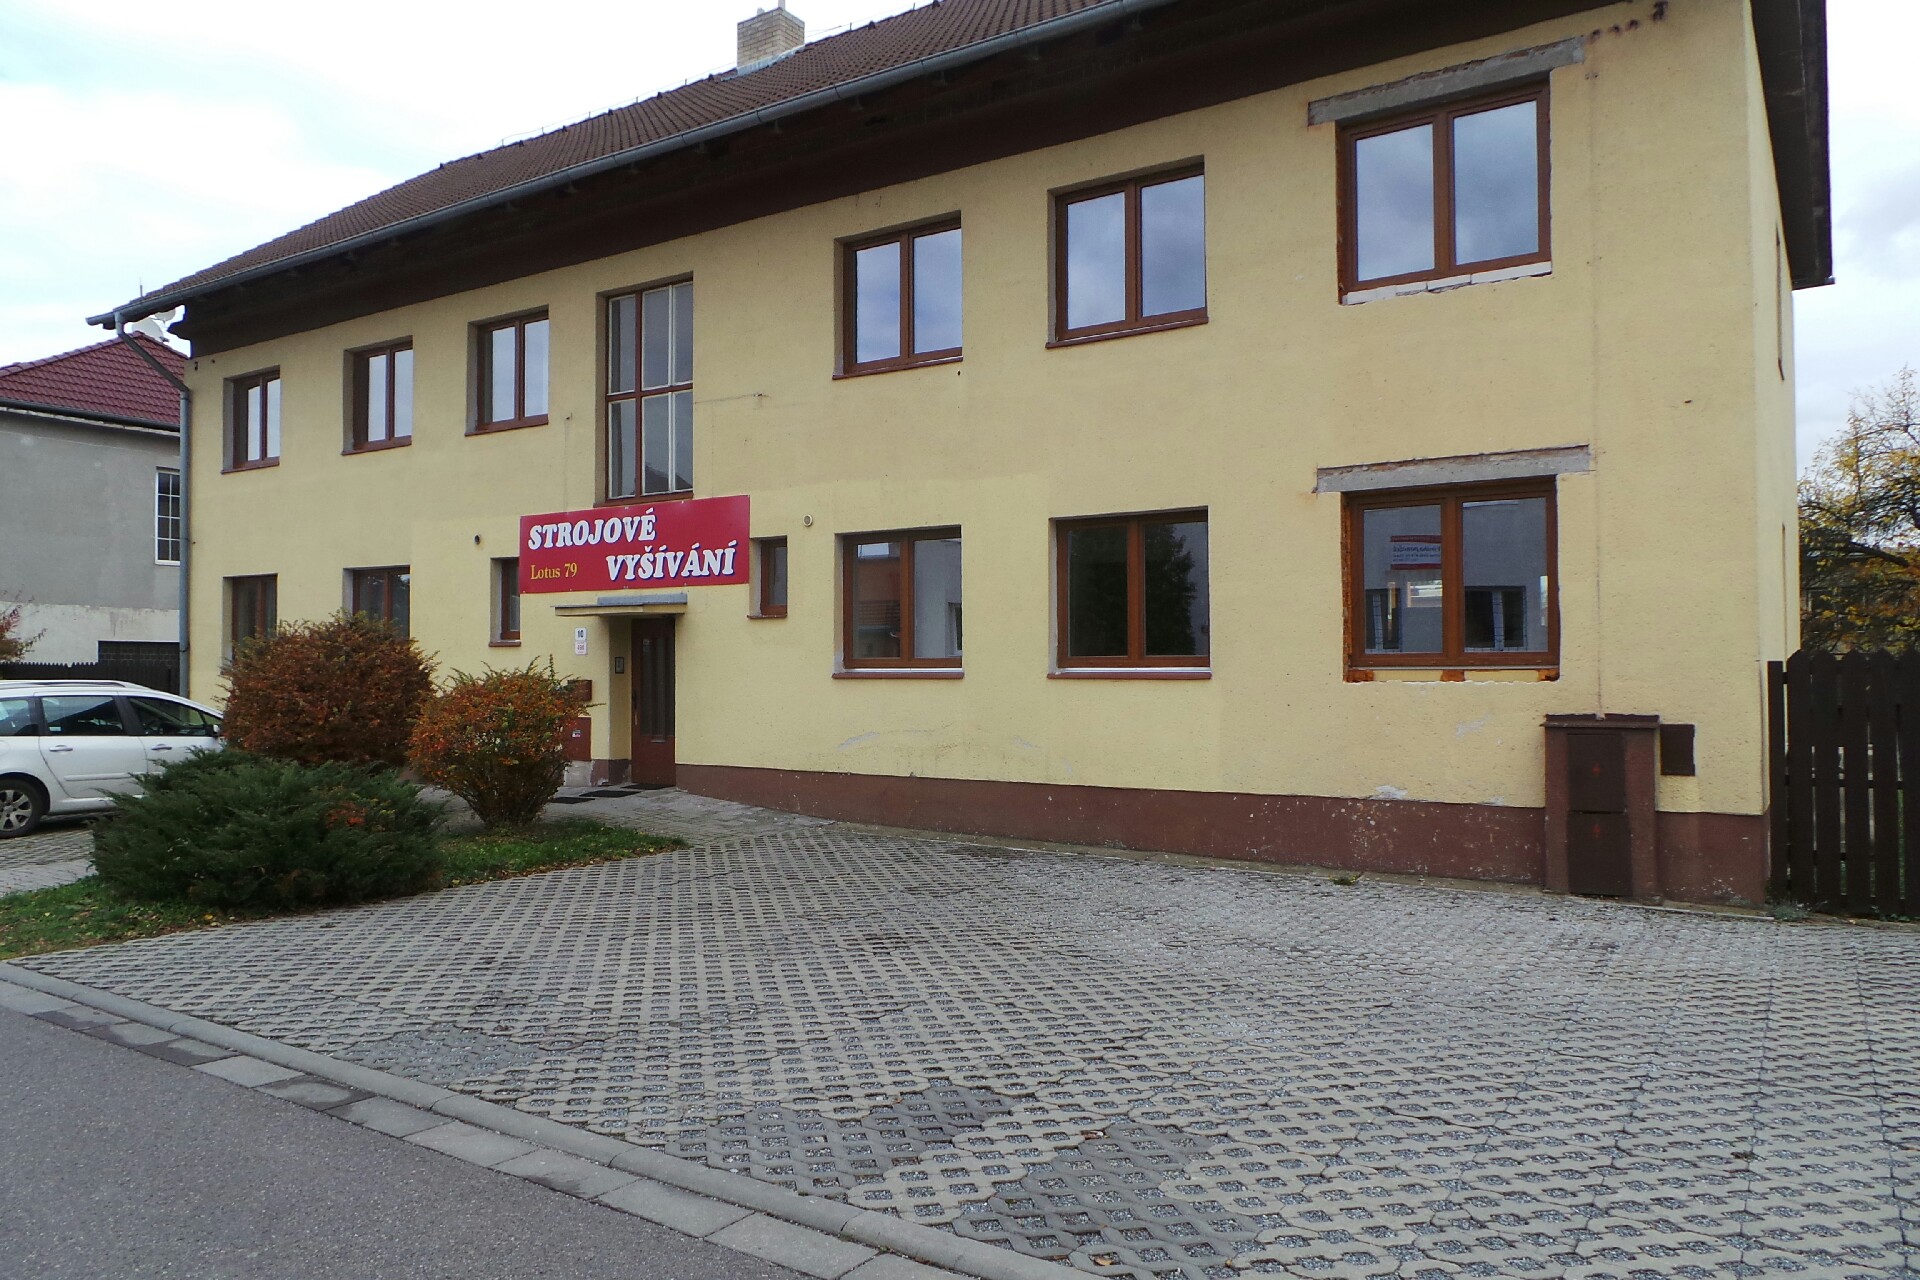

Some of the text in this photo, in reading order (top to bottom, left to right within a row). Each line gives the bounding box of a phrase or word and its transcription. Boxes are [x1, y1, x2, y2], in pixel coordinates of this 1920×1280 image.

[528, 507, 656, 550] STROJOVÉ
[530, 562, 578, 579] Lotus 79
[605, 539, 737, 581] VYŠÍVÁNÍ
